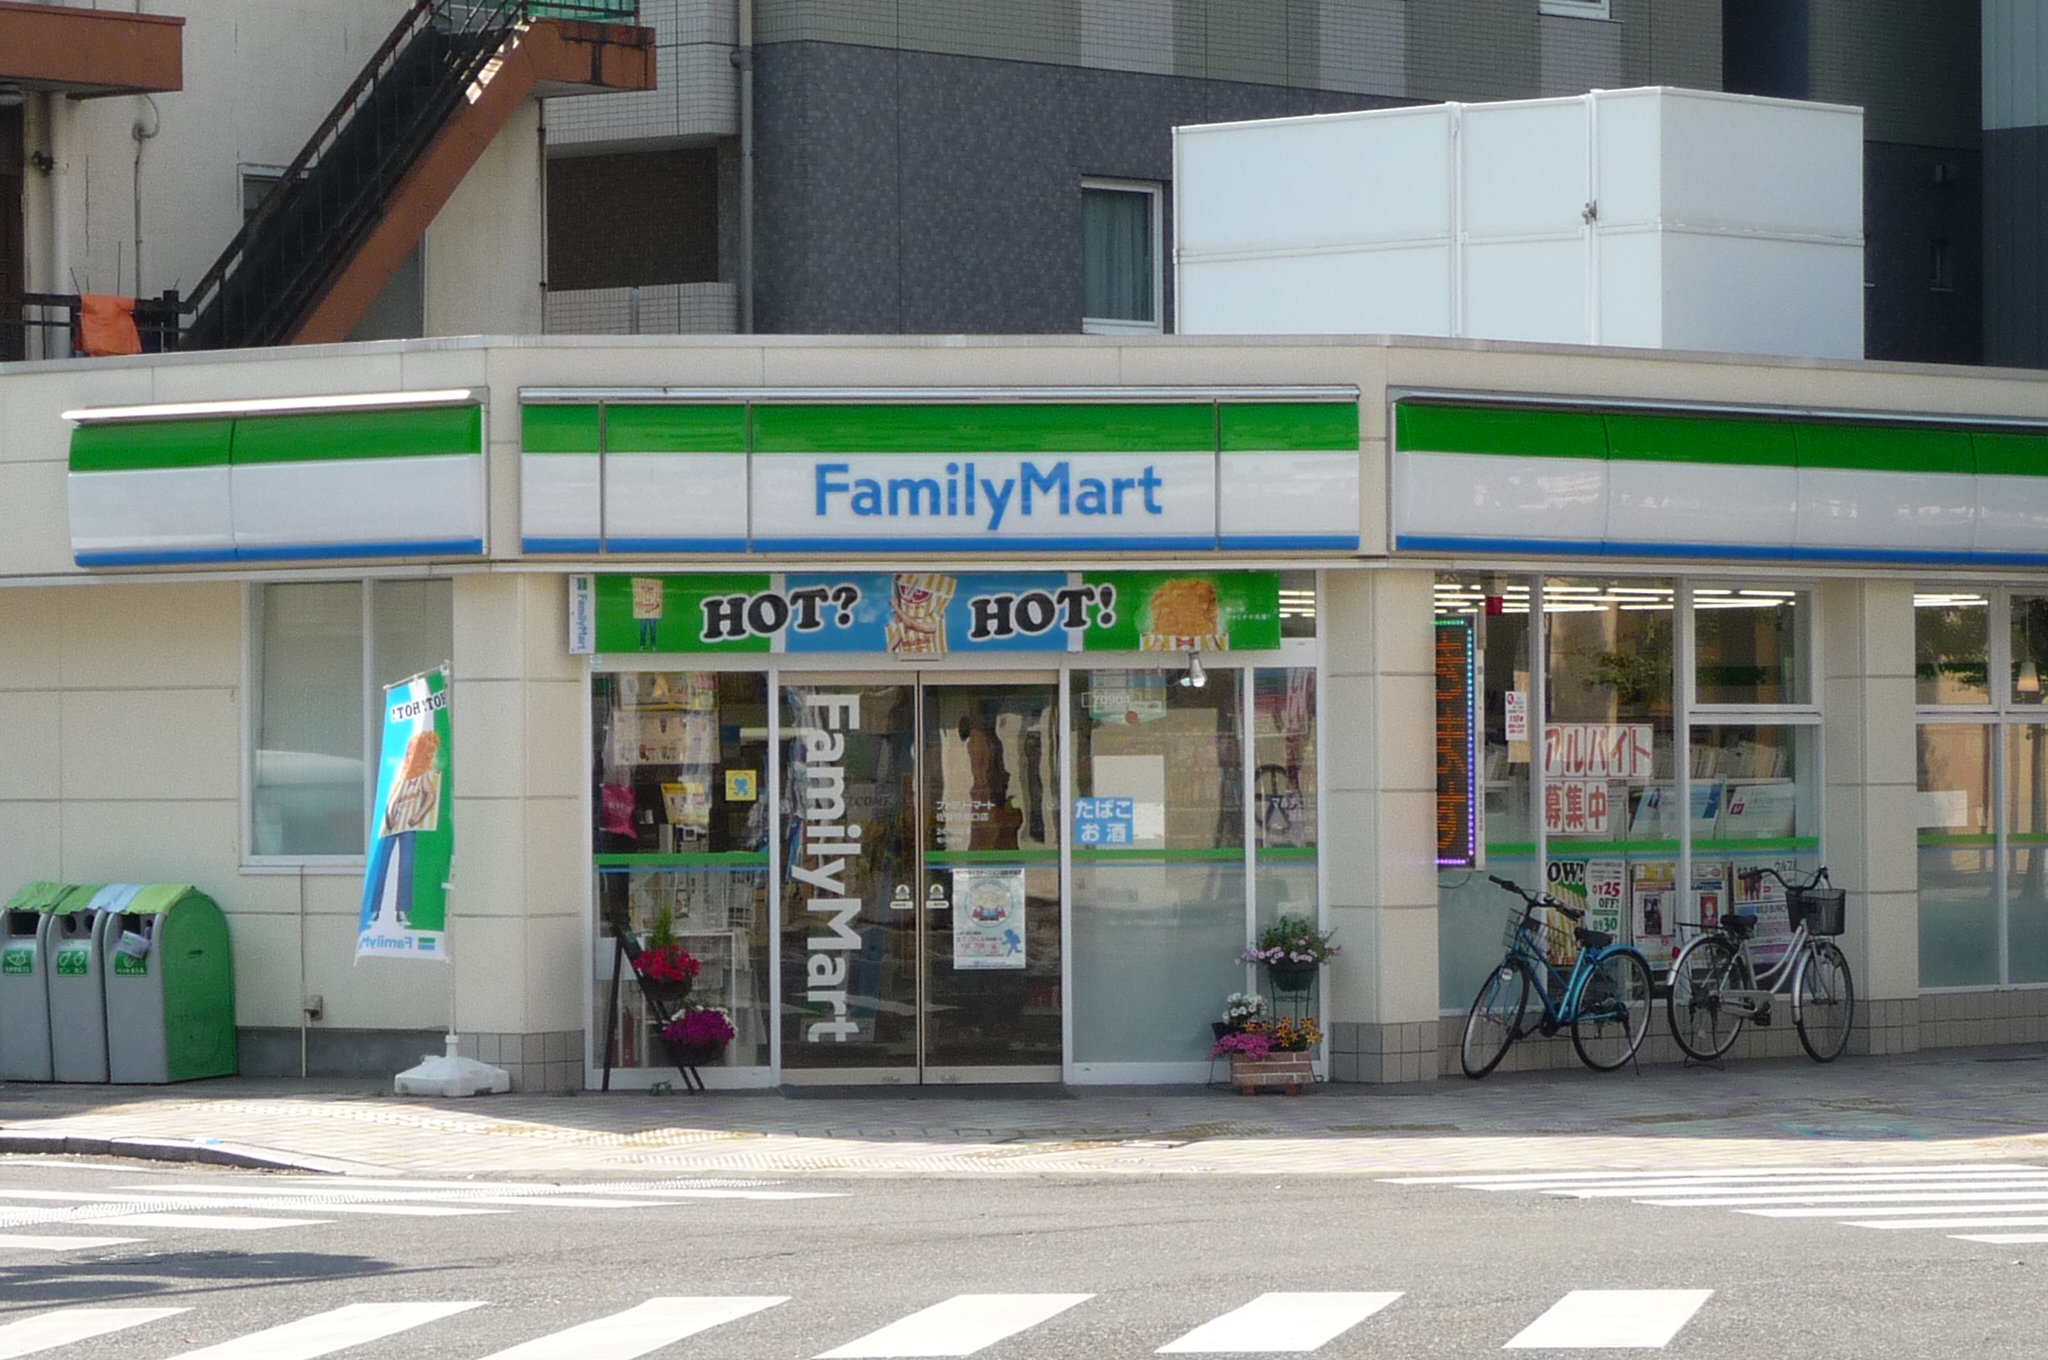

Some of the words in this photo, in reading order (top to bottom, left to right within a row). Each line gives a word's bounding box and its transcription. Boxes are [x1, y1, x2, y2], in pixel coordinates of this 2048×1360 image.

[815, 461, 1163, 531] FamilyMart
[577, 593, 588, 650] FamilyMart
[702, 586, 859, 640] HOT?
[970, 585, 1114, 639] HOT!
[1545, 727, 1652, 775] アルバイト
[1076, 800, 1132, 819] たばこ
[1545, 784, 1607, 830] 募集中
[1081, 823, 1127, 843] お酒
[791, 694, 862, 1043] FamilyMart
